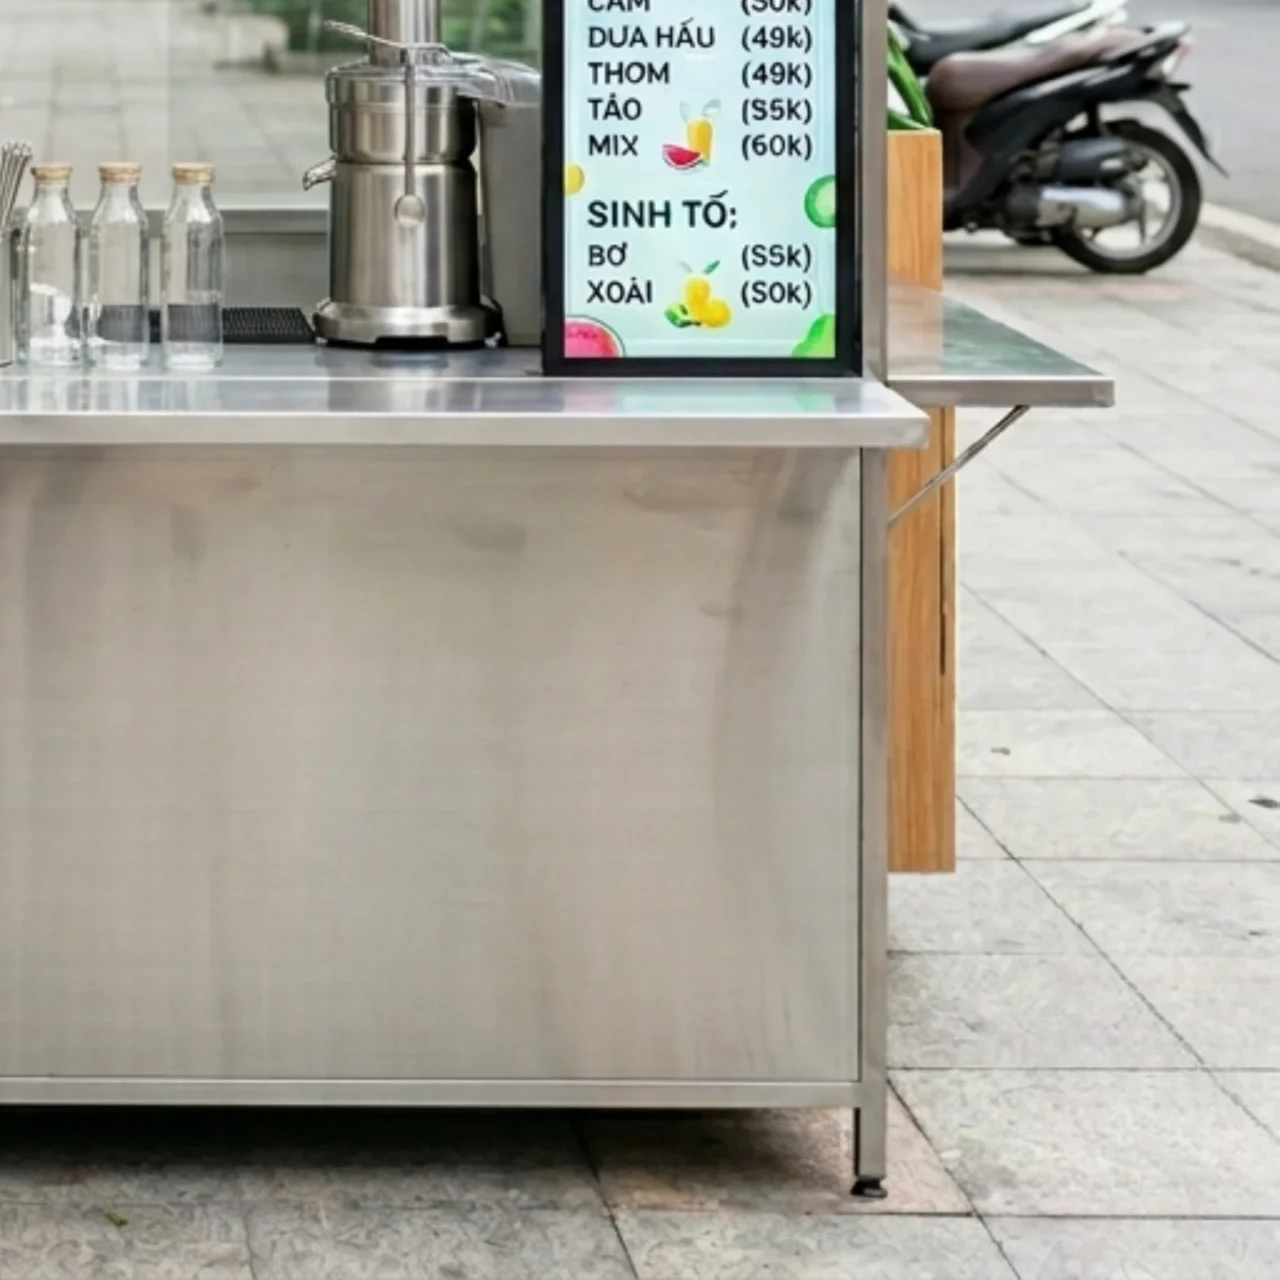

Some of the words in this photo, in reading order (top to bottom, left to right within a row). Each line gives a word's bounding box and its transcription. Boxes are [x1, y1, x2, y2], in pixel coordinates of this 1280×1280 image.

[588, 134, 639, 157] MIX
[586, 199, 672, 229] SINH
[588, 241, 628, 267] BƠ
